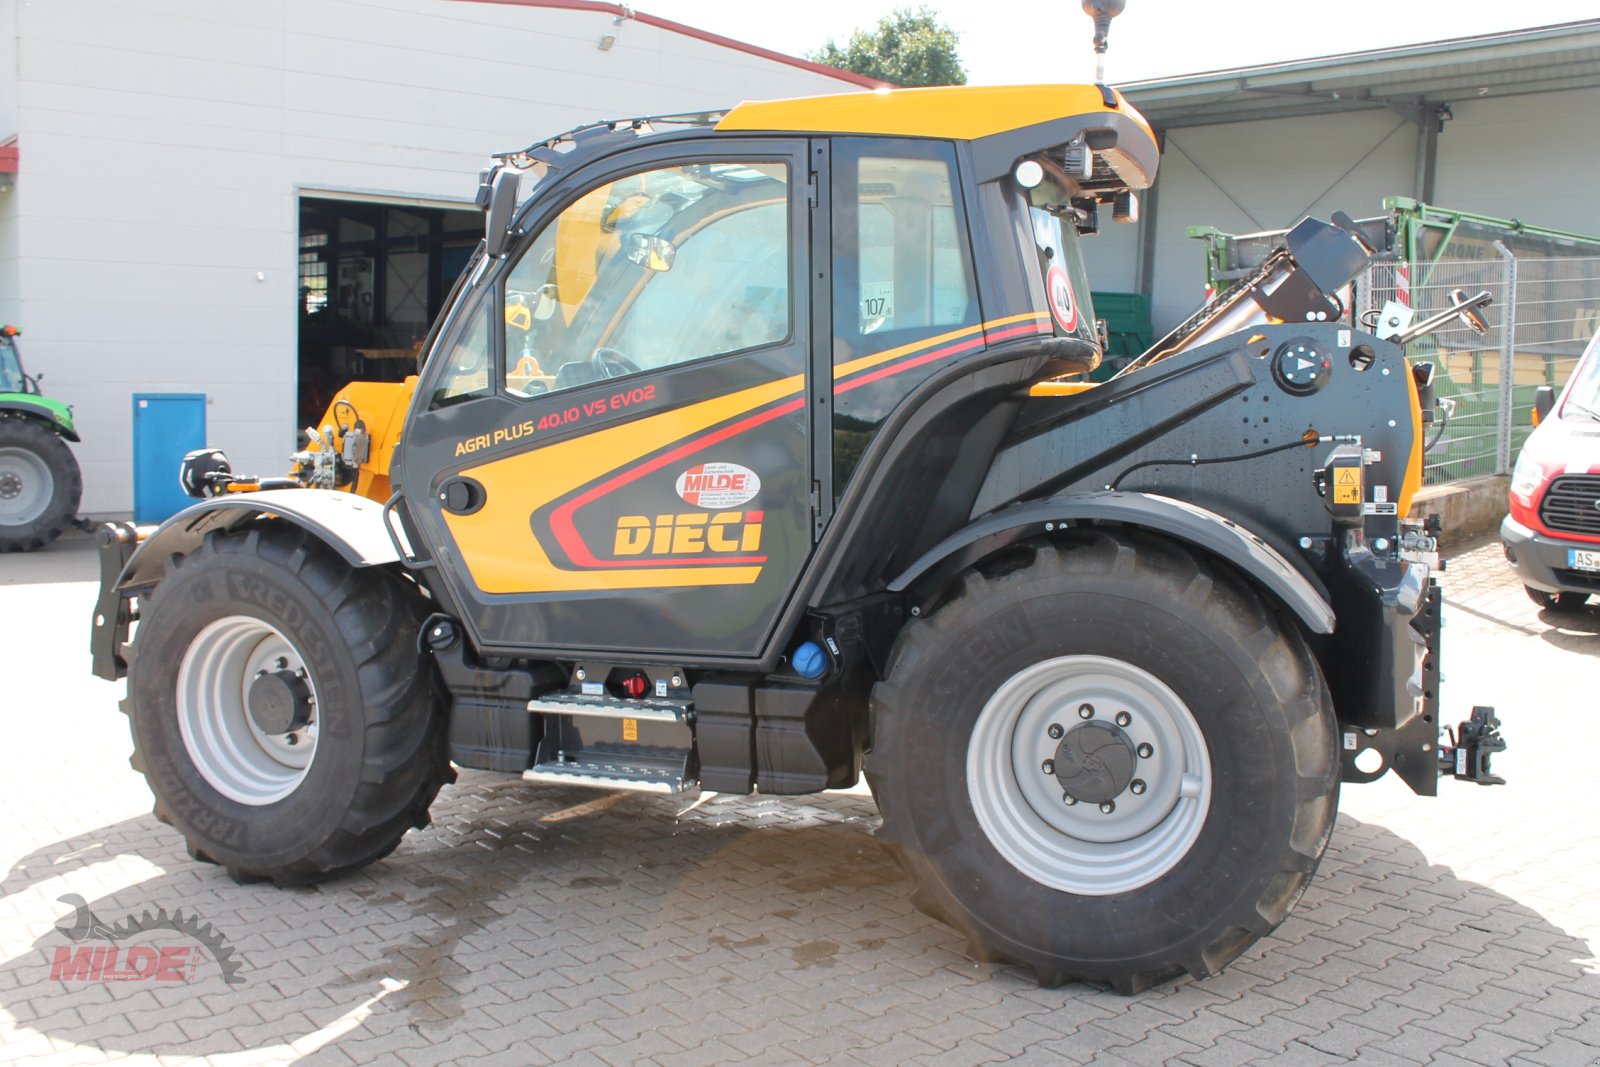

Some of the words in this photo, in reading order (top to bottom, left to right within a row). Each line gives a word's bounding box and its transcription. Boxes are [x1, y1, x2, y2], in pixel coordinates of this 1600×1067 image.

[865, 297, 885, 316] 107
[1056, 285, 1070, 311] 40
[454, 434, 490, 457] AGRI
[494, 420, 534, 445] PLUS
[537, 407, 581, 431] 40.10
[583, 397, 607, 417] VS
[683, 473, 746, 491] MILDE
[1577, 552, 1593, 566] AS
